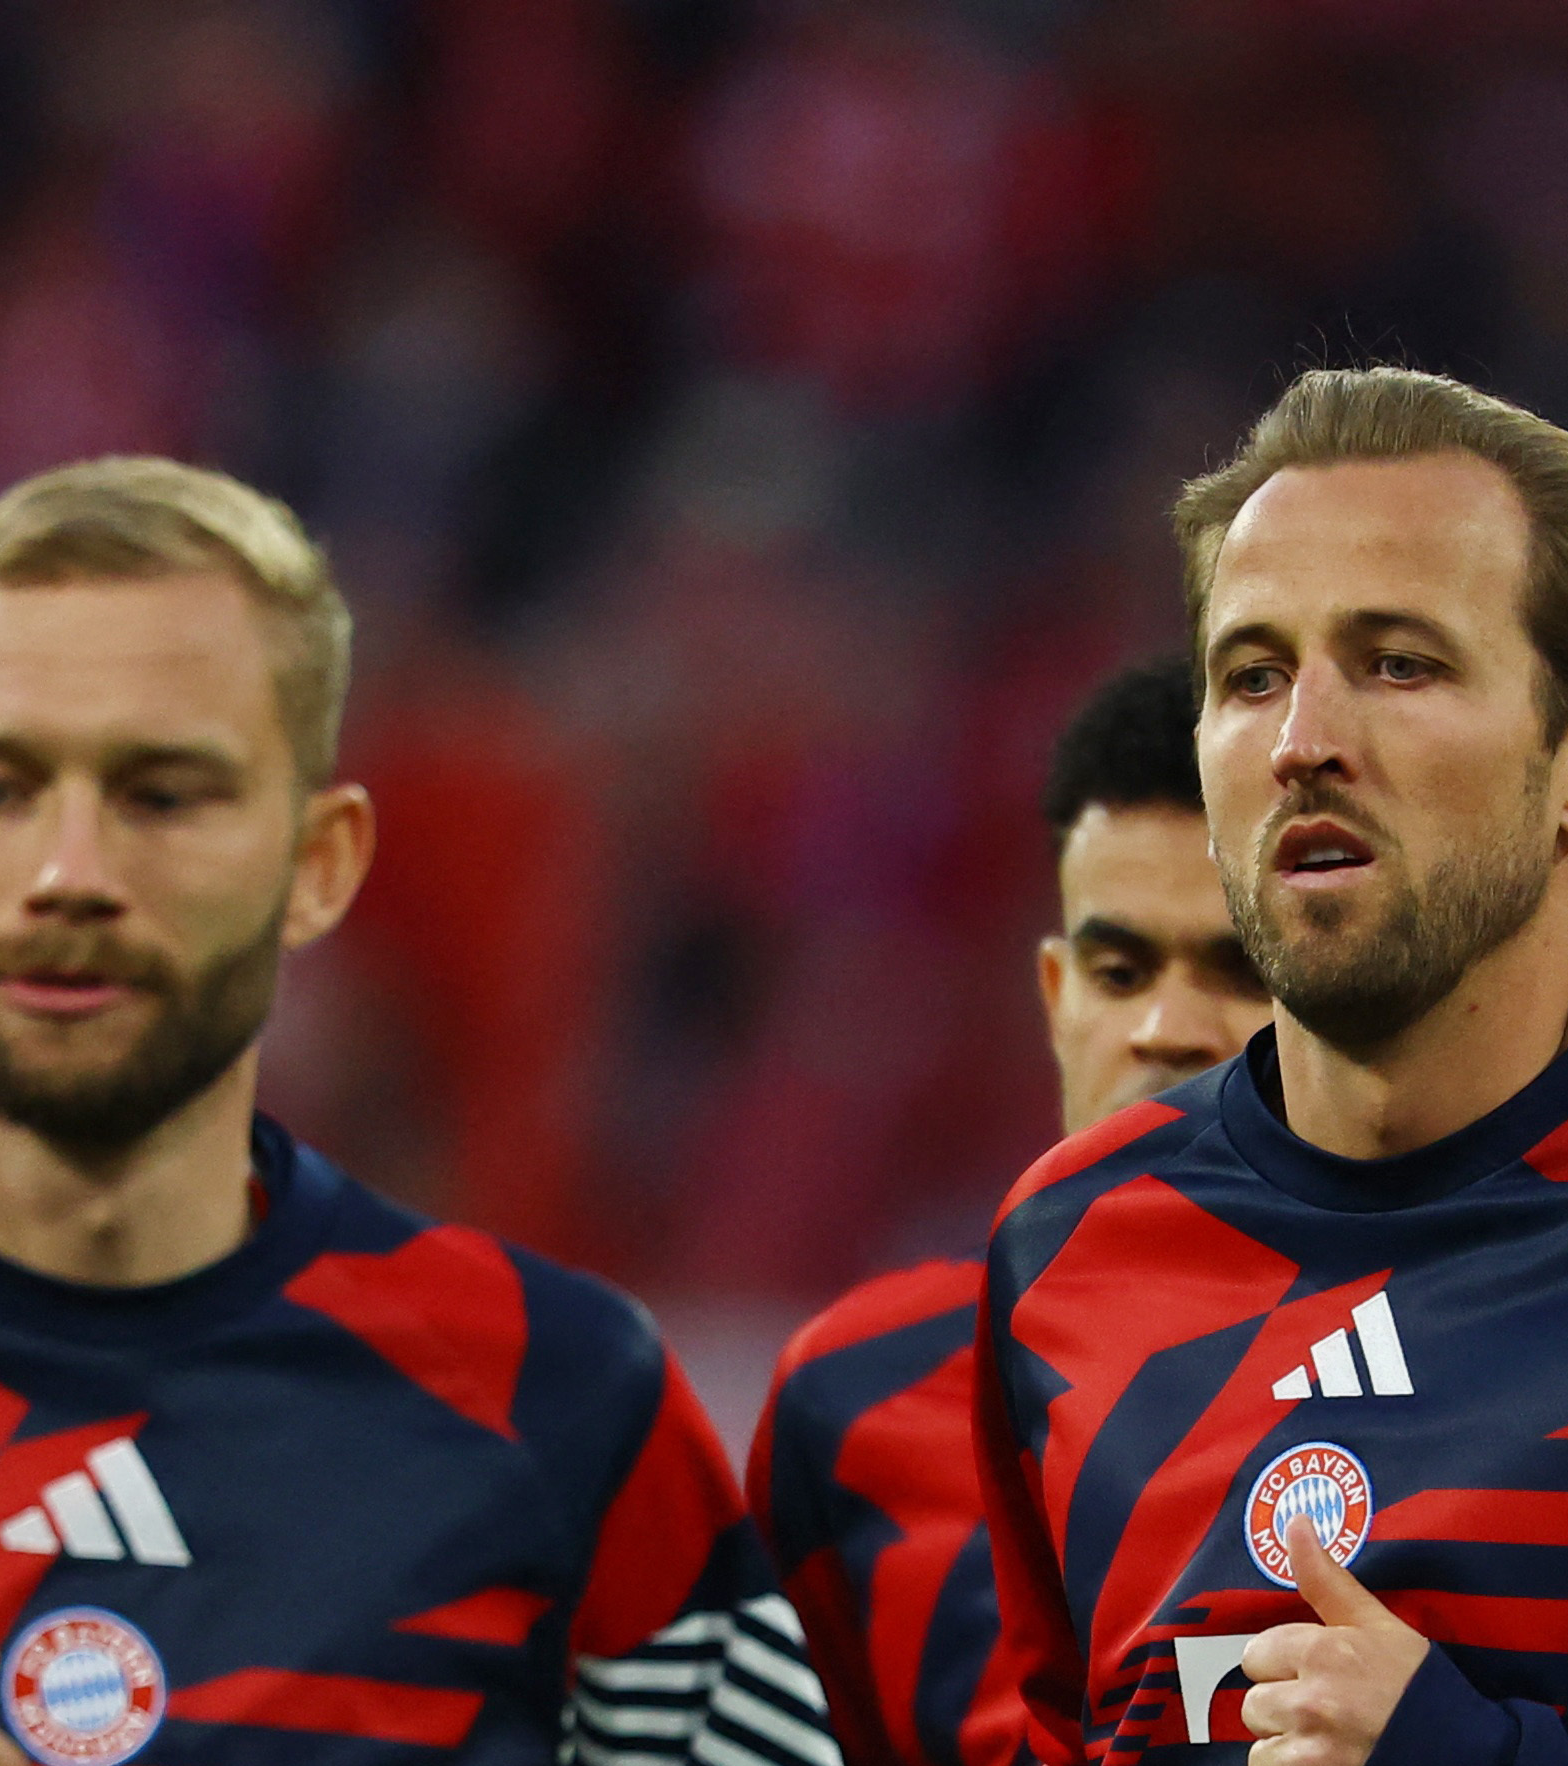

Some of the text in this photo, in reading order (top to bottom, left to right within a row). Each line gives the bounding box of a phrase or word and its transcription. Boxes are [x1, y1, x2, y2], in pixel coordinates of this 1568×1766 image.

[1259, 1453, 1365, 1505] FC BAYERN
[1253, 1528, 1358, 1577] MÜNEN
